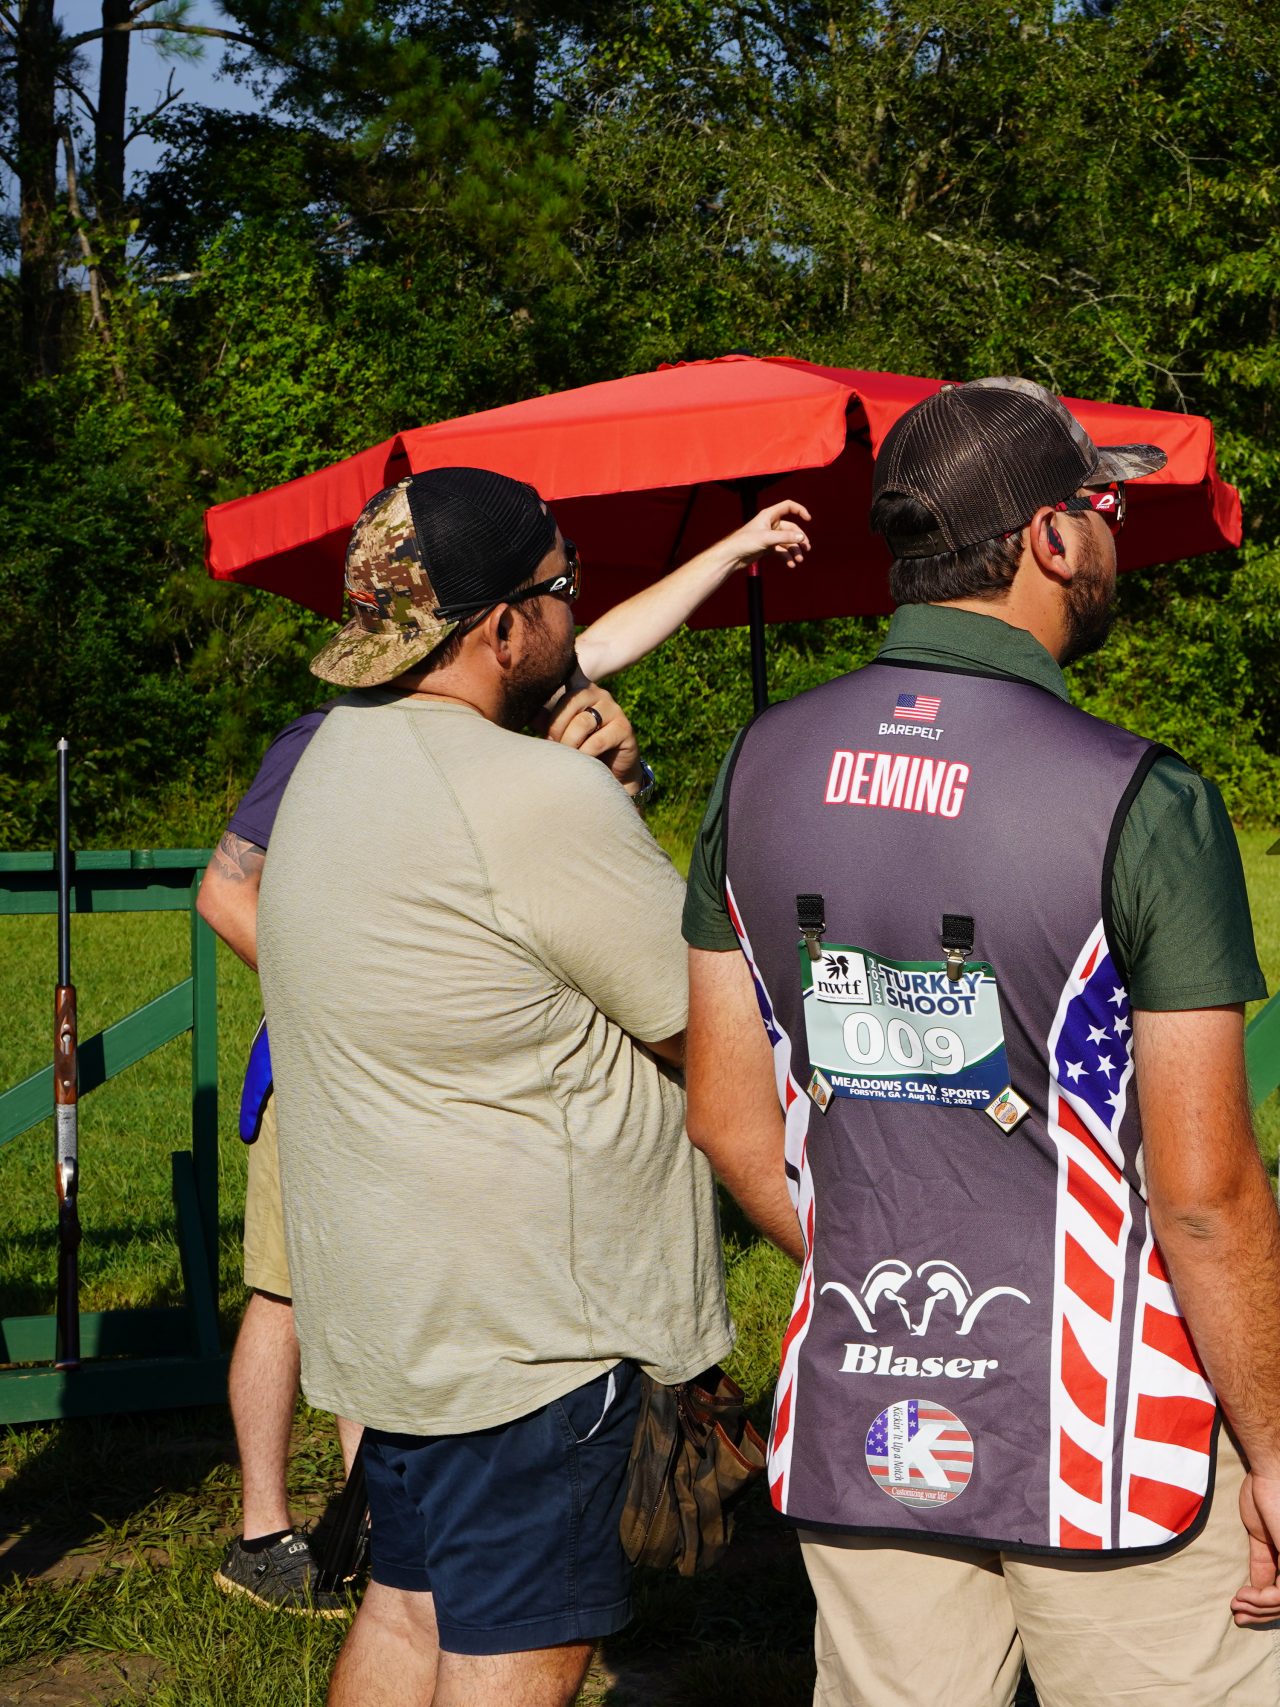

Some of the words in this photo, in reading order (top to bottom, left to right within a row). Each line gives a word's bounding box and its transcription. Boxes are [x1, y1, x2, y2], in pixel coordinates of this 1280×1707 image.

[879, 723, 944, 740] BAREPELT
[824, 750, 970, 818] DEMING
[817, 980, 862, 995] nwtf
[867, 957, 883, 1004] 2023
[880, 966, 981, 995] TURKEY
[886, 987, 976, 1015] SHOOT
[842, 1011, 965, 1074] 009
[831, 1075, 902, 1091] MEADOWS
[905, 1081, 937, 1095] CLAY
[940, 1087, 991, 1100] SPORTS
[850, 1088, 886, 1098] FORSYTH,
[908, 1092, 925, 1101] Aug
[839, 1343, 998, 1379] Blaser
[891, 1442, 904, 1453] Up
[894, 1461, 905, 1481] Notch
[891, 1486, 924, 1499] Customizing
[925, 1491, 937, 1499] your
